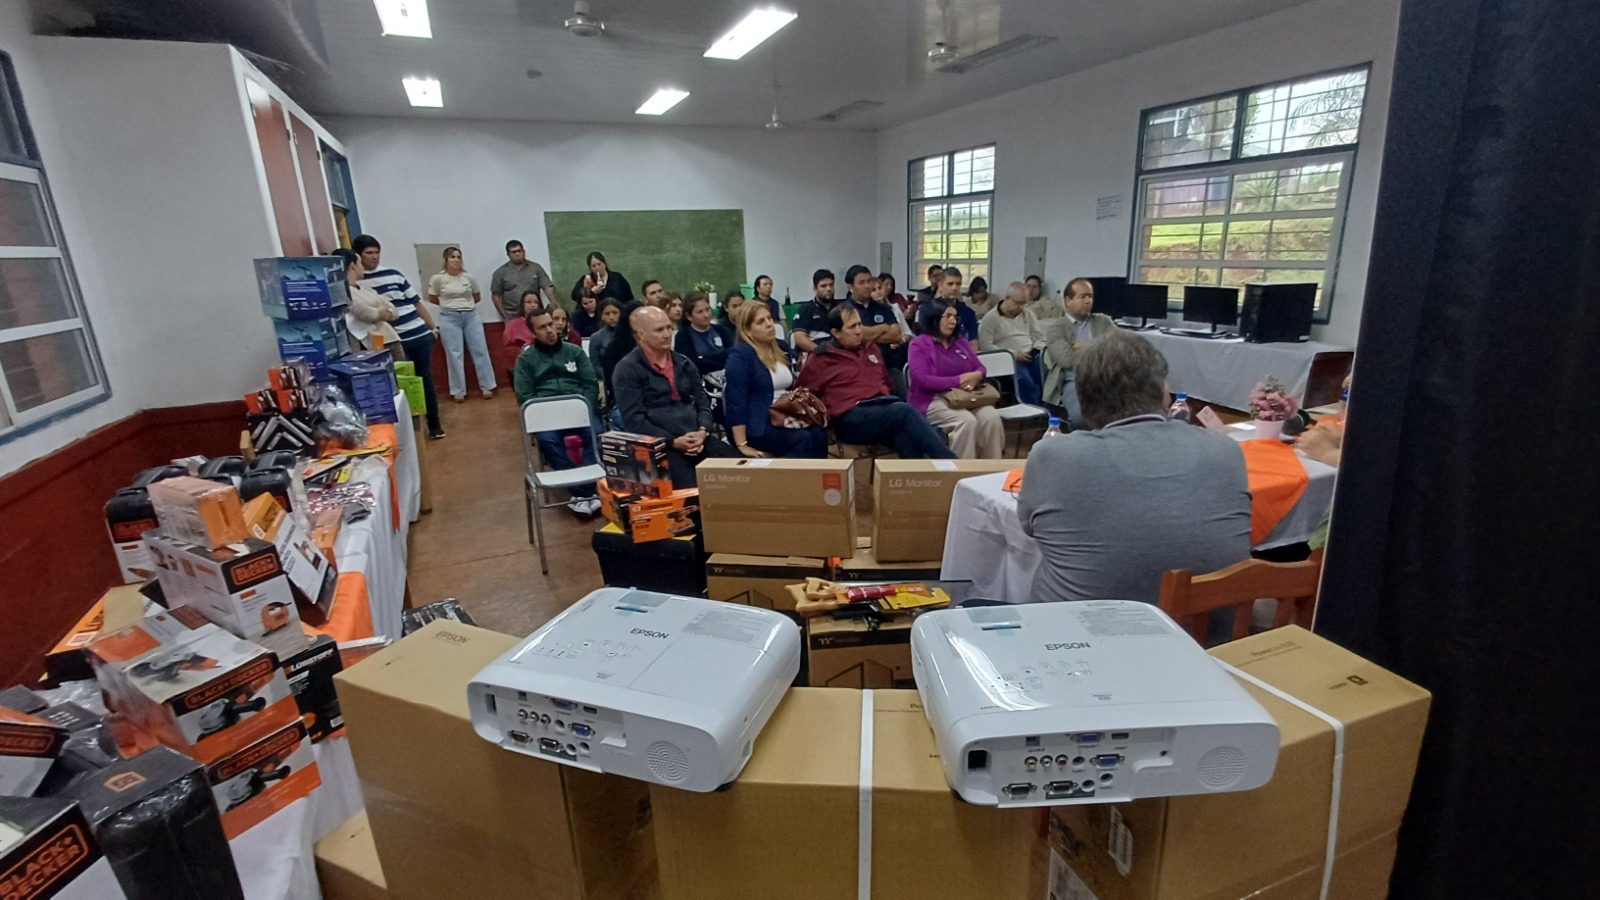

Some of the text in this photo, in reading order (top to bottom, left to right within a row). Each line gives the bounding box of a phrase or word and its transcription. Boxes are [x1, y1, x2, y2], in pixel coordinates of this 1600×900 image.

[703, 473, 751, 482] LG Monitor
[889, 479, 942, 488] LG Monitor
[435, 630, 471, 643] EPSON
[630, 627, 670, 640] EPSON
[1045, 641, 1091, 651] EPSON
